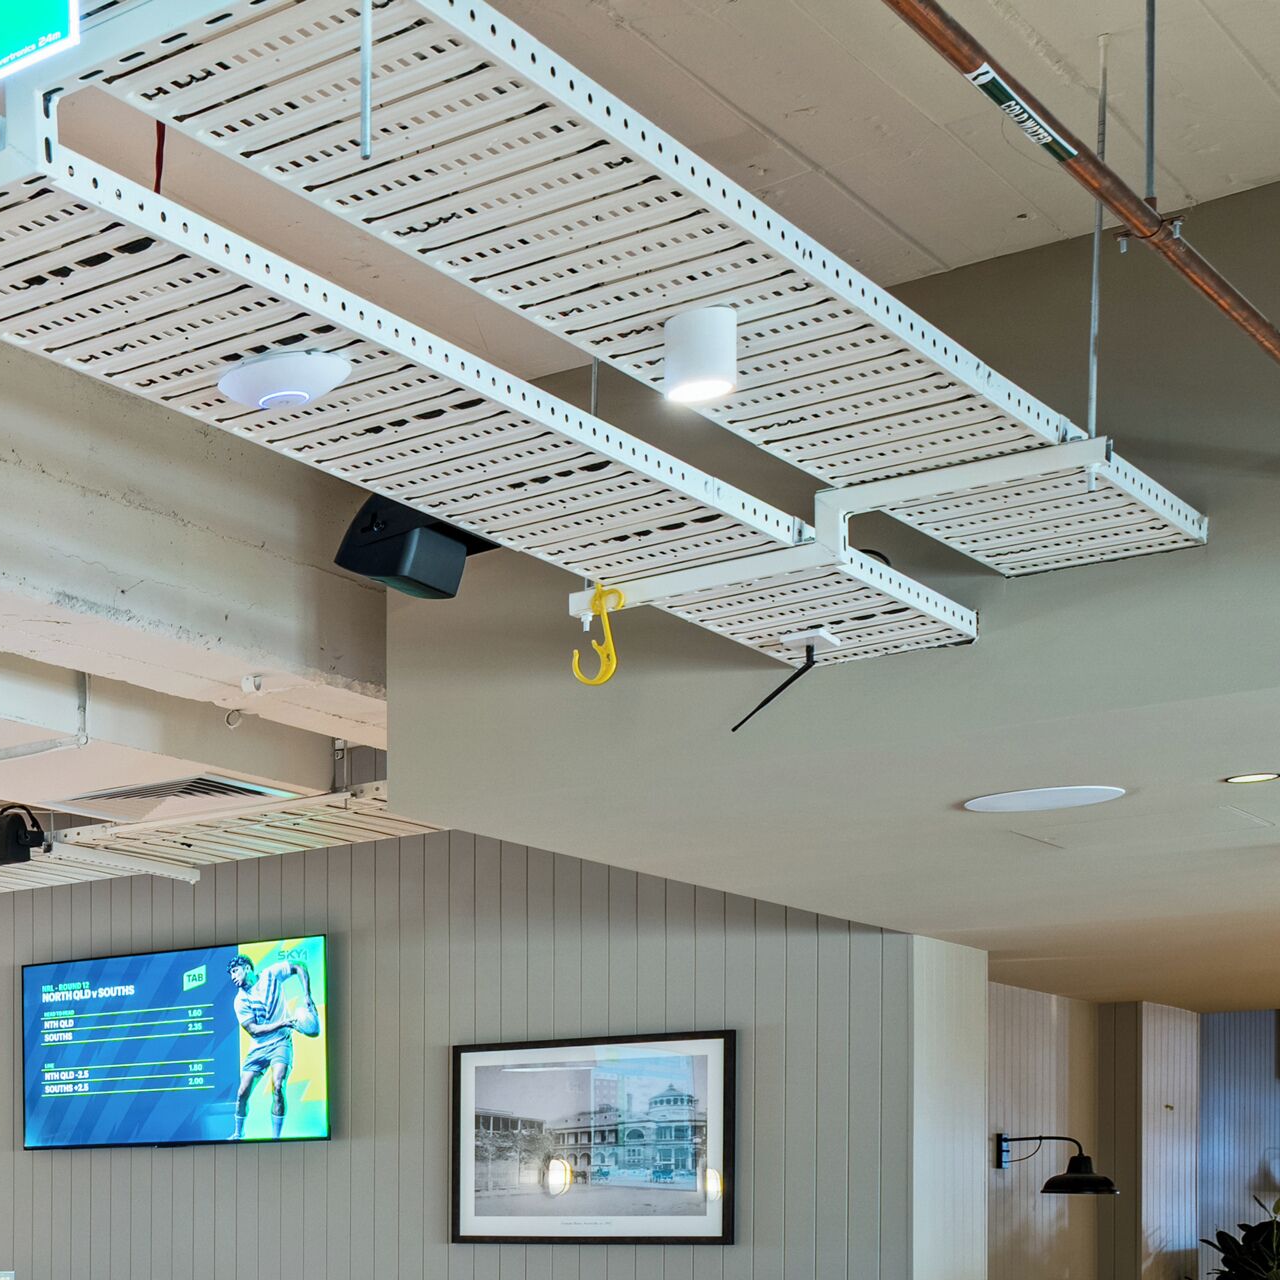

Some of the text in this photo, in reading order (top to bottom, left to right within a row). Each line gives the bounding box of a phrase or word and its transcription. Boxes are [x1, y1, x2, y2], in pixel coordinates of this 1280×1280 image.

[38, 31, 61, 48] 24m
[1000, 100, 1054, 145] COLD WATER
[186, 973, 204, 983] TAB
[42, 986, 134, 1002] NORTH QLD SOUTHS
[44, 1019, 74, 1029] NTH QLD
[44, 1032, 72, 1042] SOUTHS
[44, 1071, 75, 1081] NTH QLD
[45, 1084, 74, 1094] SOUTHS
